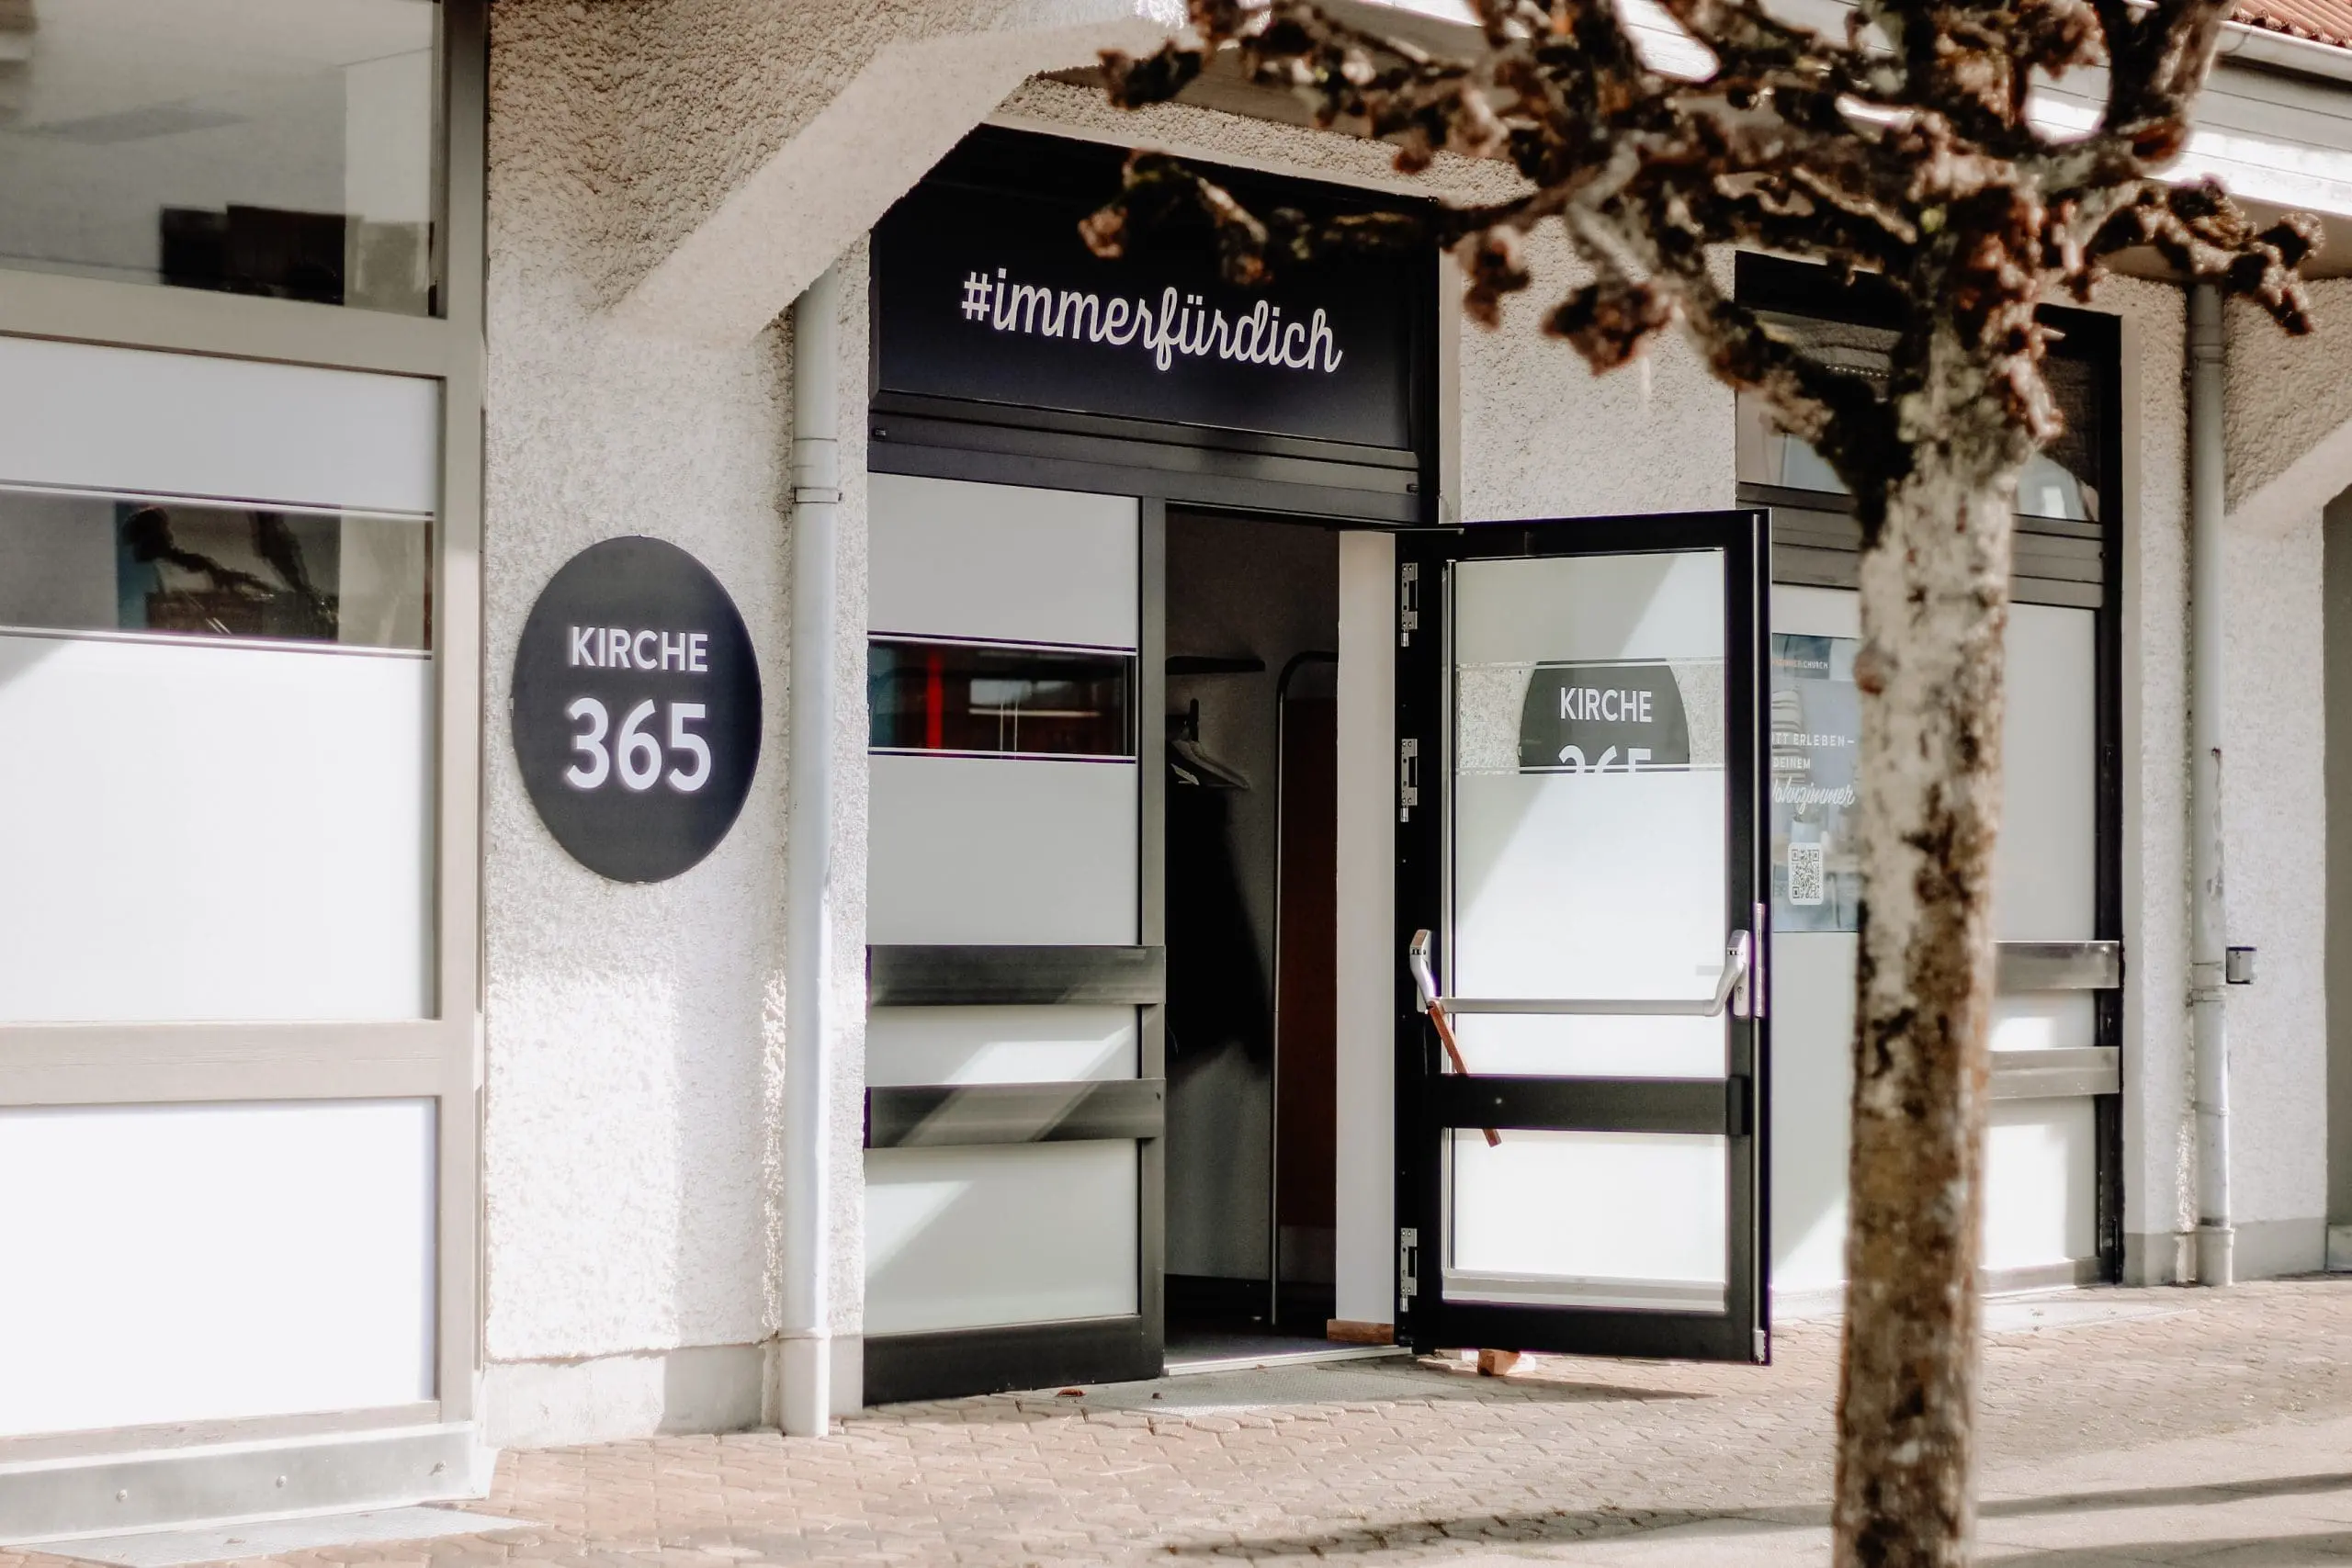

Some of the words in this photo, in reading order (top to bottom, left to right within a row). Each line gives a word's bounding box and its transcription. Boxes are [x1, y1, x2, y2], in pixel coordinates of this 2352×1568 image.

[961, 267, 1343, 372] #immerfürdich
[571, 626, 708, 672] KIRCHE
[1559, 687, 1653, 723] KIRCHE
[566, 697, 711, 792] 365
[1771, 732, 1788, 745] TT
[1773, 756, 1810, 769] DEINEM
